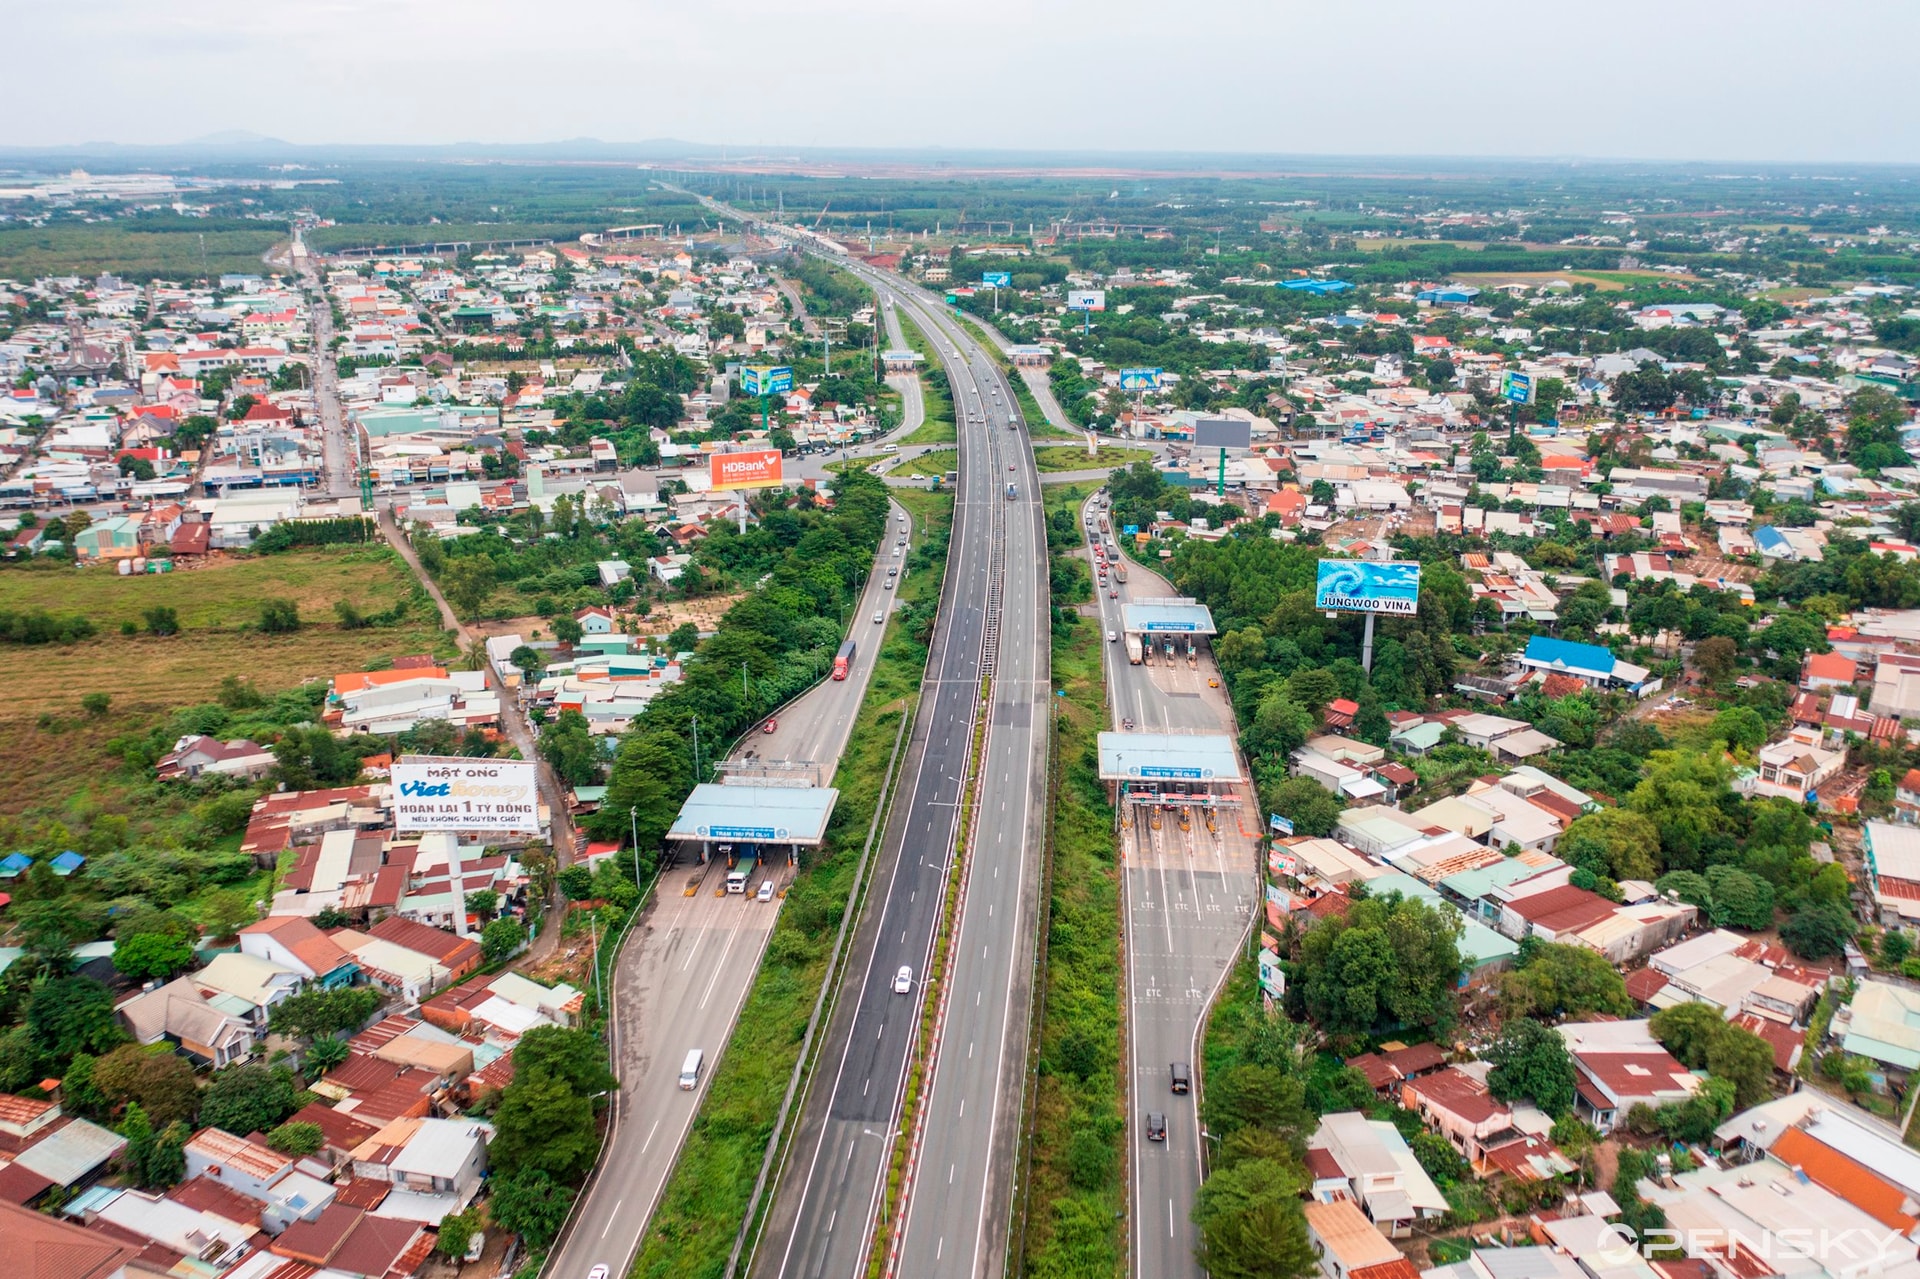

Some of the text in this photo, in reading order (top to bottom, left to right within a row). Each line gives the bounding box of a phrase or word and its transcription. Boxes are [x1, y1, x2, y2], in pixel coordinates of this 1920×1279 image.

[722, 460, 765, 473] HDBank
[1322, 597, 1411, 611] JUNGWOO VINA
[465, 769, 499, 778] ONG
[462, 801, 472, 813] 1
[1206, 904, 1221, 912] ETC
[1234, 905, 1249, 913] ETC
[1146, 989, 1161, 997] ETC
